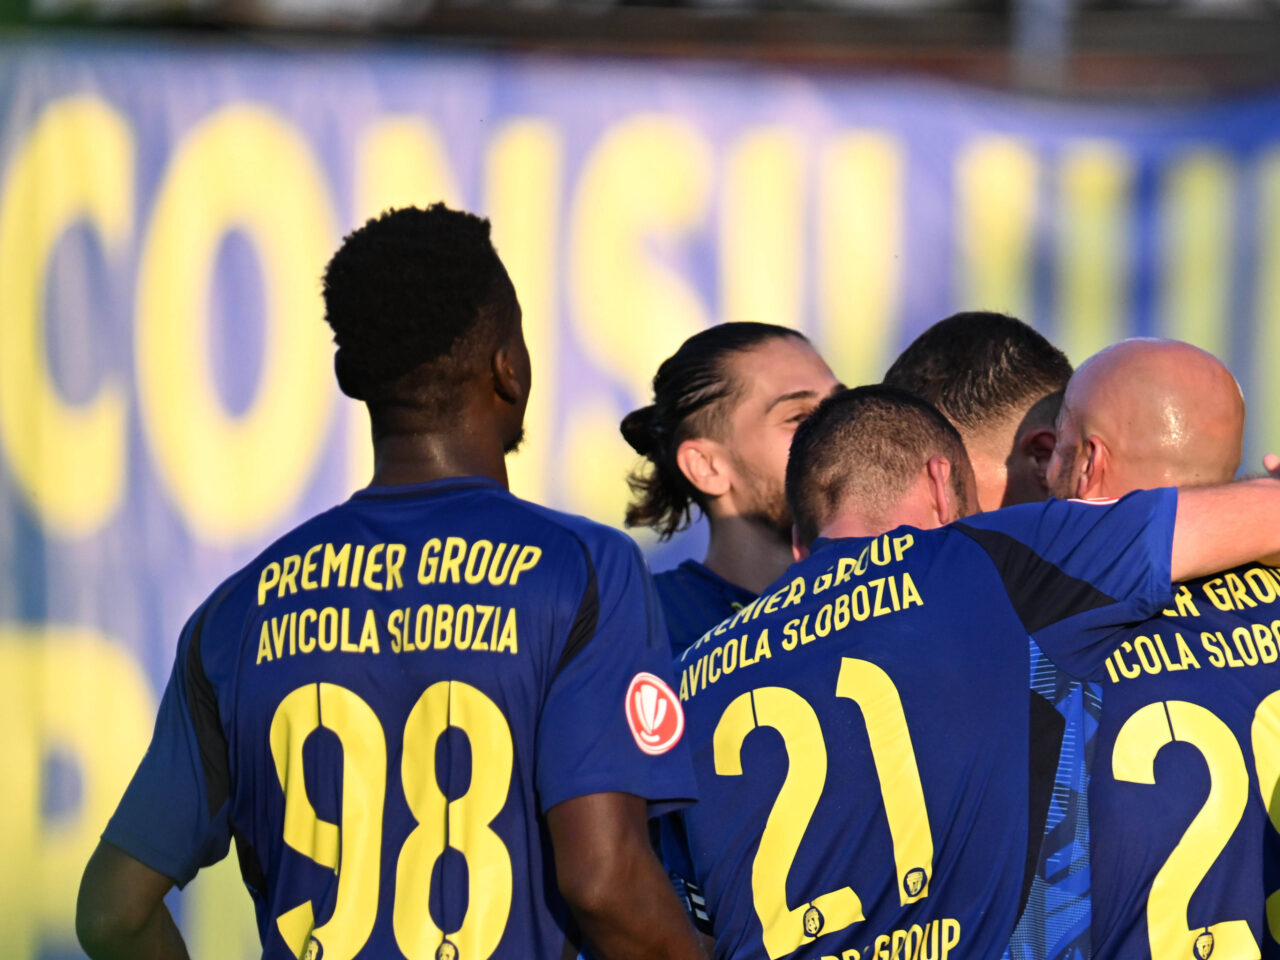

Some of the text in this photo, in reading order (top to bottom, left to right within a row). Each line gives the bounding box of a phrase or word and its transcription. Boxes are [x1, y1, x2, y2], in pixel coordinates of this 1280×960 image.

[257, 536, 542, 606] PREMIER GROUP
[256, 603, 518, 666] AVICOLA SLOBOZIA
[679, 571, 924, 702] AVICOLA SLOBOZIA
[712, 656, 934, 960] 21
